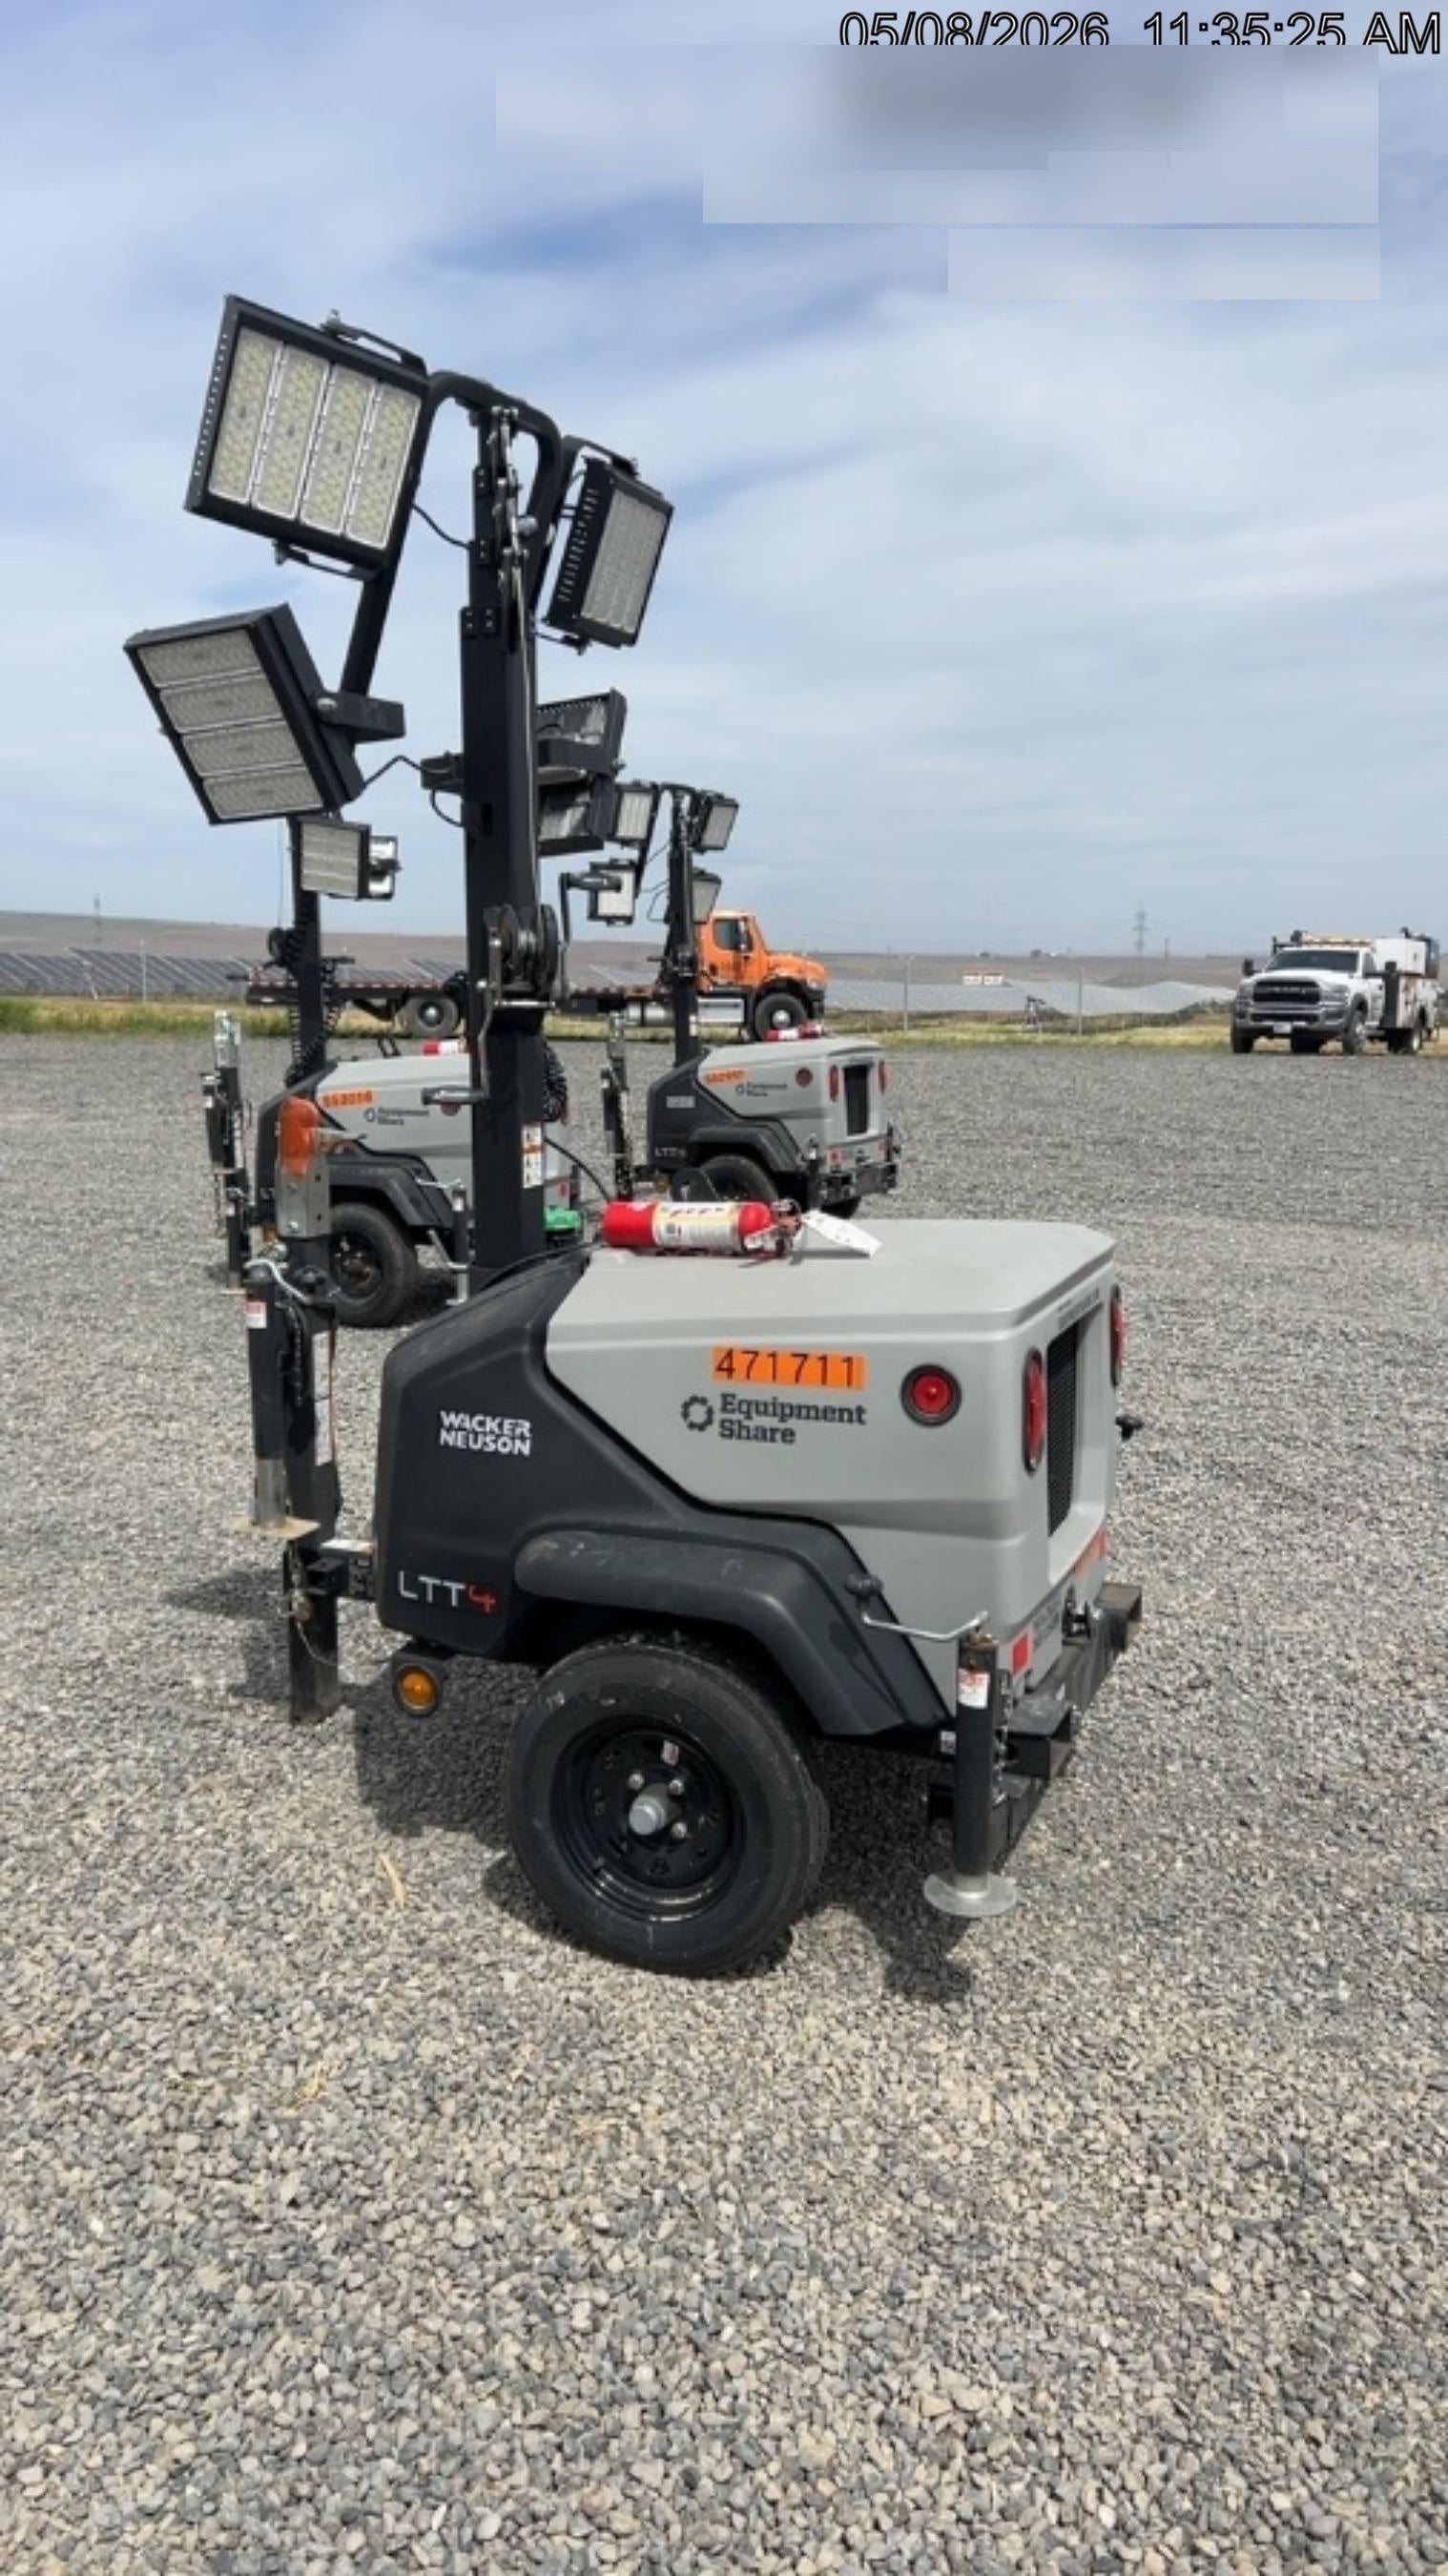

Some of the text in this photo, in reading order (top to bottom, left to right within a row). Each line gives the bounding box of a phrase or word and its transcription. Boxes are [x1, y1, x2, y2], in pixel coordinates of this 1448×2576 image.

[715, 1347, 855, 1387] 471711
[440, 1410, 530, 1437] WACKER
[719, 1392, 867, 1425] Equipment
[440, 1428, 530, 1456] NEUSON
[718, 1419, 796, 1444] Share
[398, 1570, 495, 1612] LTT4
